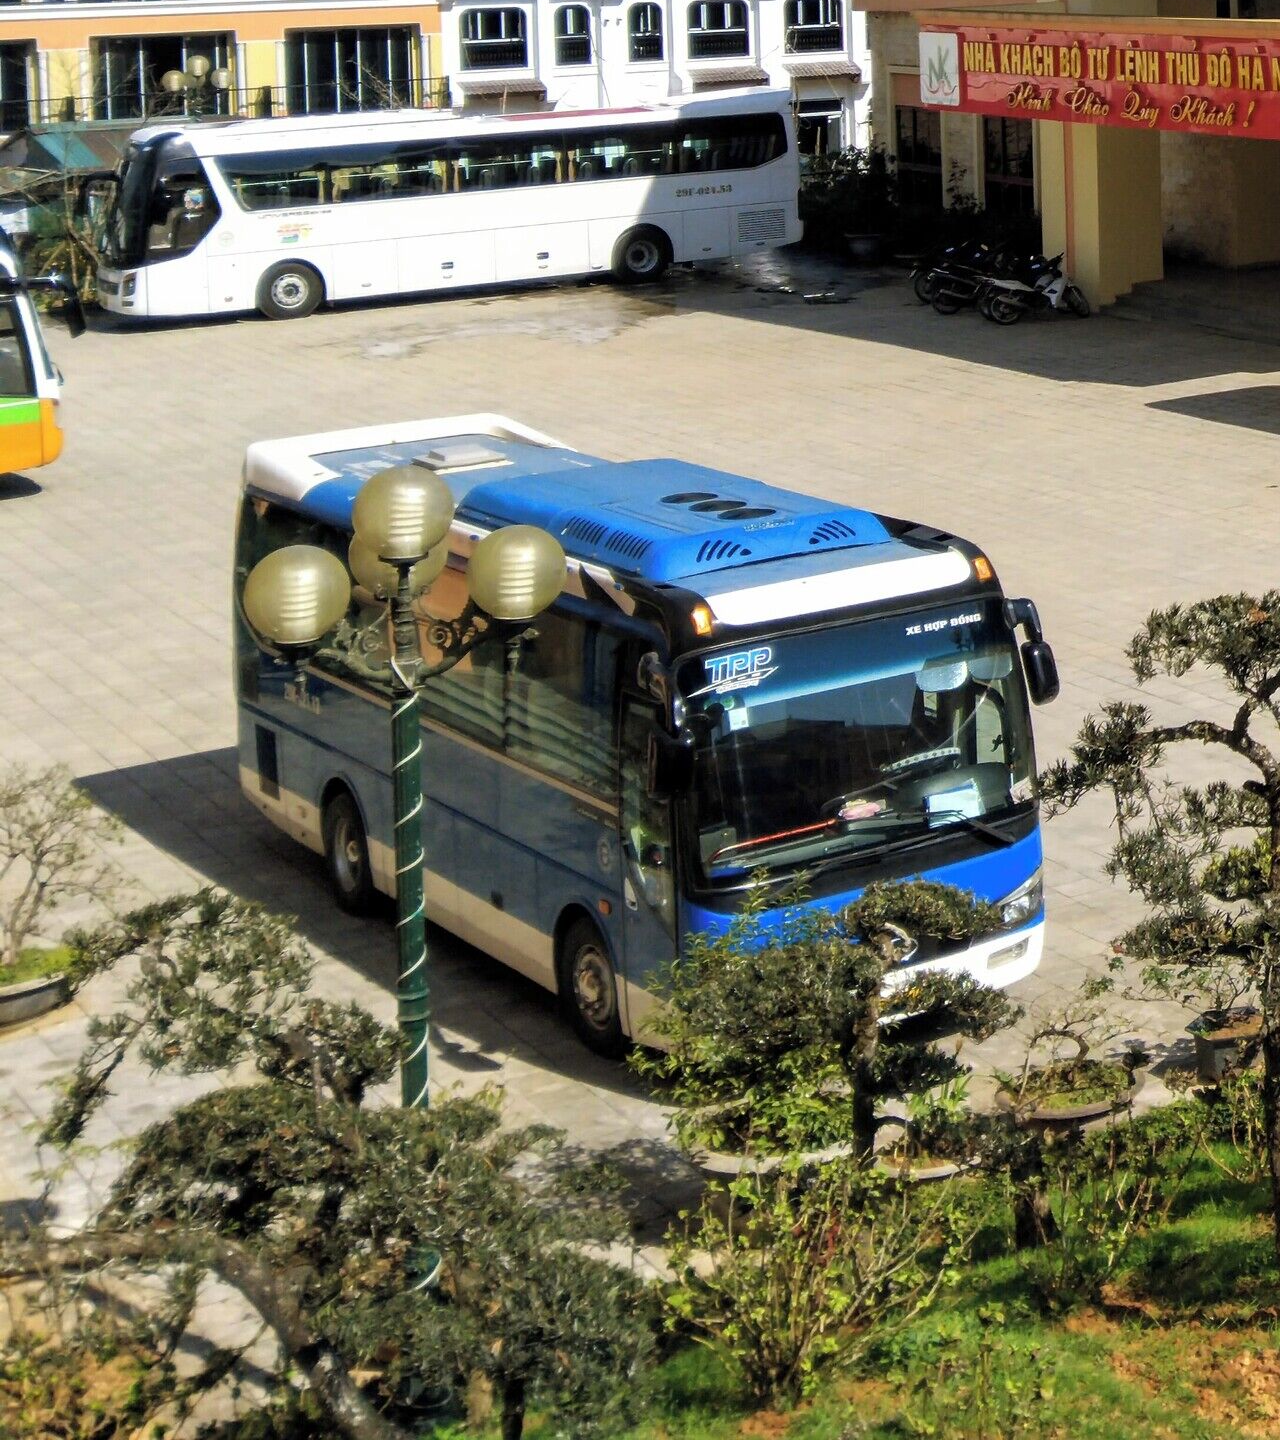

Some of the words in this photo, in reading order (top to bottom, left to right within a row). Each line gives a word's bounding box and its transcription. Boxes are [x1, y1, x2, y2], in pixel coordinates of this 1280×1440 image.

[963, 33, 996, 73] NHÀ
[1000, 36, 1054, 77] KHÁCH
[1087, 45, 1110, 81] TƯ
[1116, 40, 1160, 91] LỆNH
[1165, 39, 1201, 87] THỦ
[1206, 47, 1232, 88] ĐÔ
[1237, 46, 1265, 91] HÀ
[1064, 87, 1110, 117] Chào
[1170, 95, 1236, 127] Khách
[905, 625, 922, 635] XE
[705, 647, 772, 682] TPP
